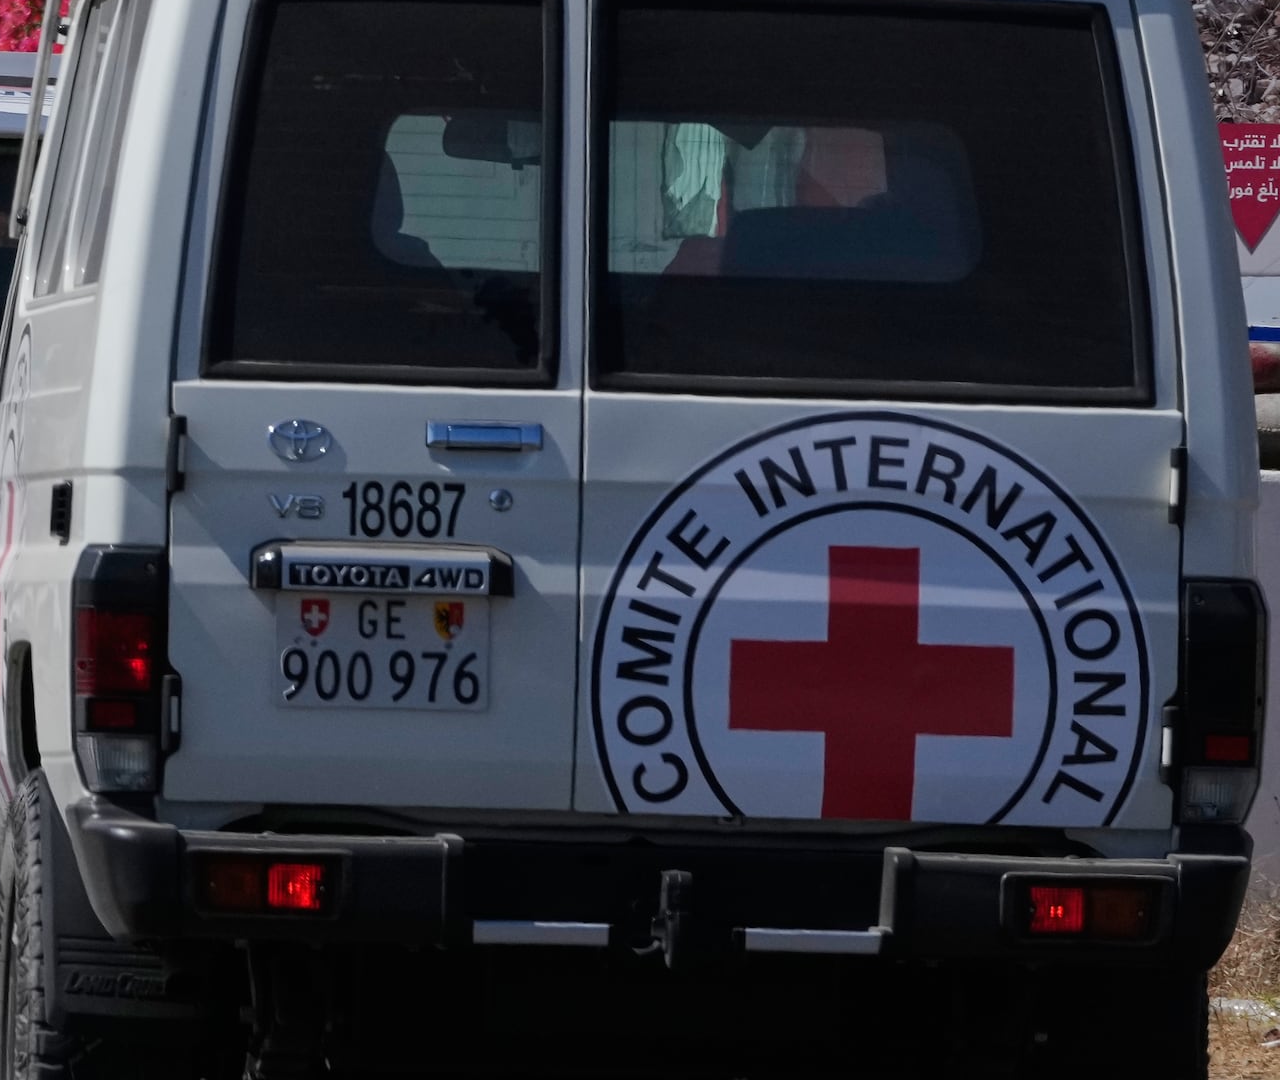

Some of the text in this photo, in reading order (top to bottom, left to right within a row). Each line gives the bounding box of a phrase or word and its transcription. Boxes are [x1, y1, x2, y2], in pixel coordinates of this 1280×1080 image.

[1225, 156, 1265, 173] تلمس
[269, 481, 465, 537] V8 18687
[295, 564, 485, 589] TOYOTA 4WD
[358, 600, 405, 639] GE
[617, 435, 1127, 804] COMITE INTERNATIONAL
[281, 648, 479, 705] 900 976
